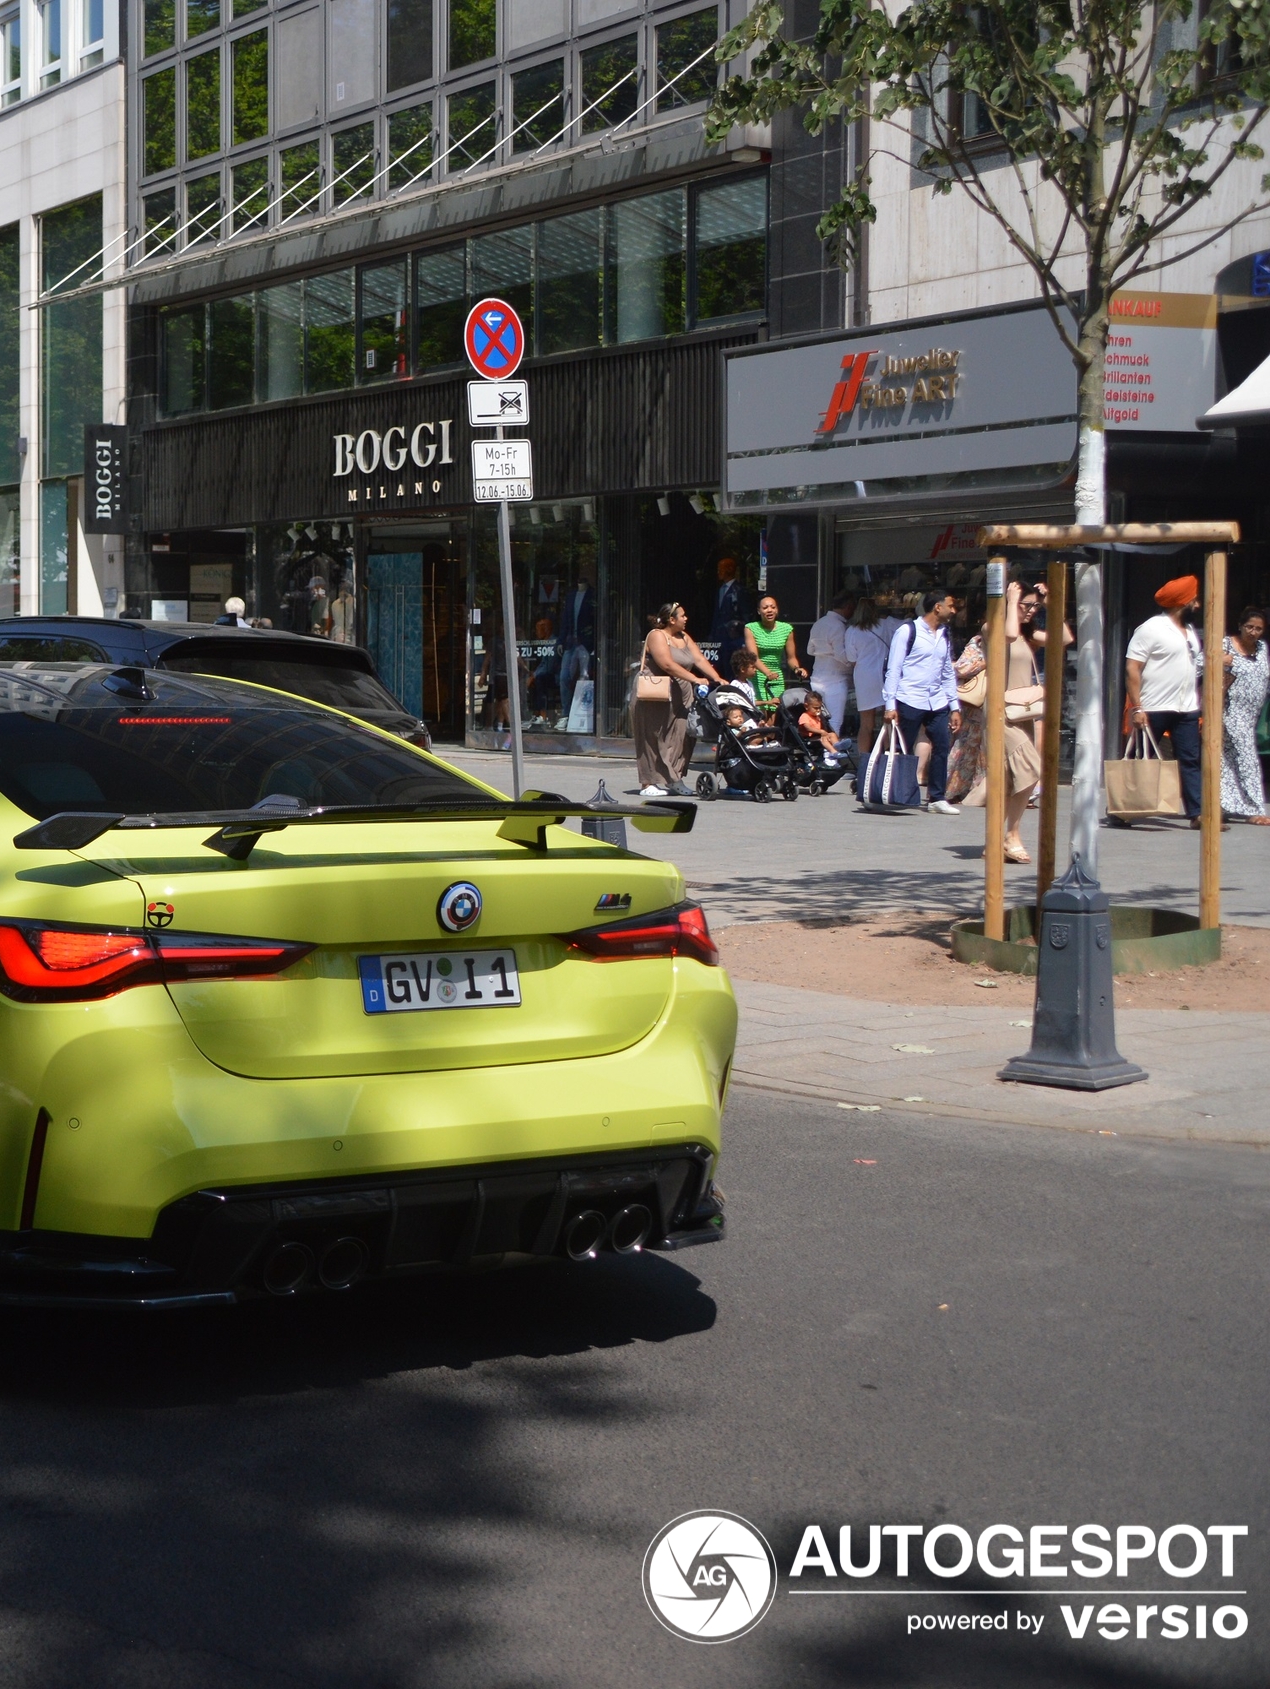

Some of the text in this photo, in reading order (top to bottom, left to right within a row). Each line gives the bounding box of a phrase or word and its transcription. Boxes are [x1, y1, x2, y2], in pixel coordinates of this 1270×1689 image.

[1108, 334, 1132, 347] hren
[880, 348, 961, 377] Juwelier
[1104, 353, 1149, 366] chmuck
[861, 373, 960, 409] Fine ART
[1103, 389, 1154, 403] delsteine
[333, 419, 453, 477] BOGGI
[485, 447, 517, 459] Mo-Fr
[490, 463, 516, 476] 7-15h
[95, 439, 112, 519] BOGGI
[348, 480, 441, 502] MILANO
[951, 537, 974, 549] Fine
[521, 647, 533, 658] ZU
[385, 960, 433, 1003] GV
[369, 989, 379, 1002] D
